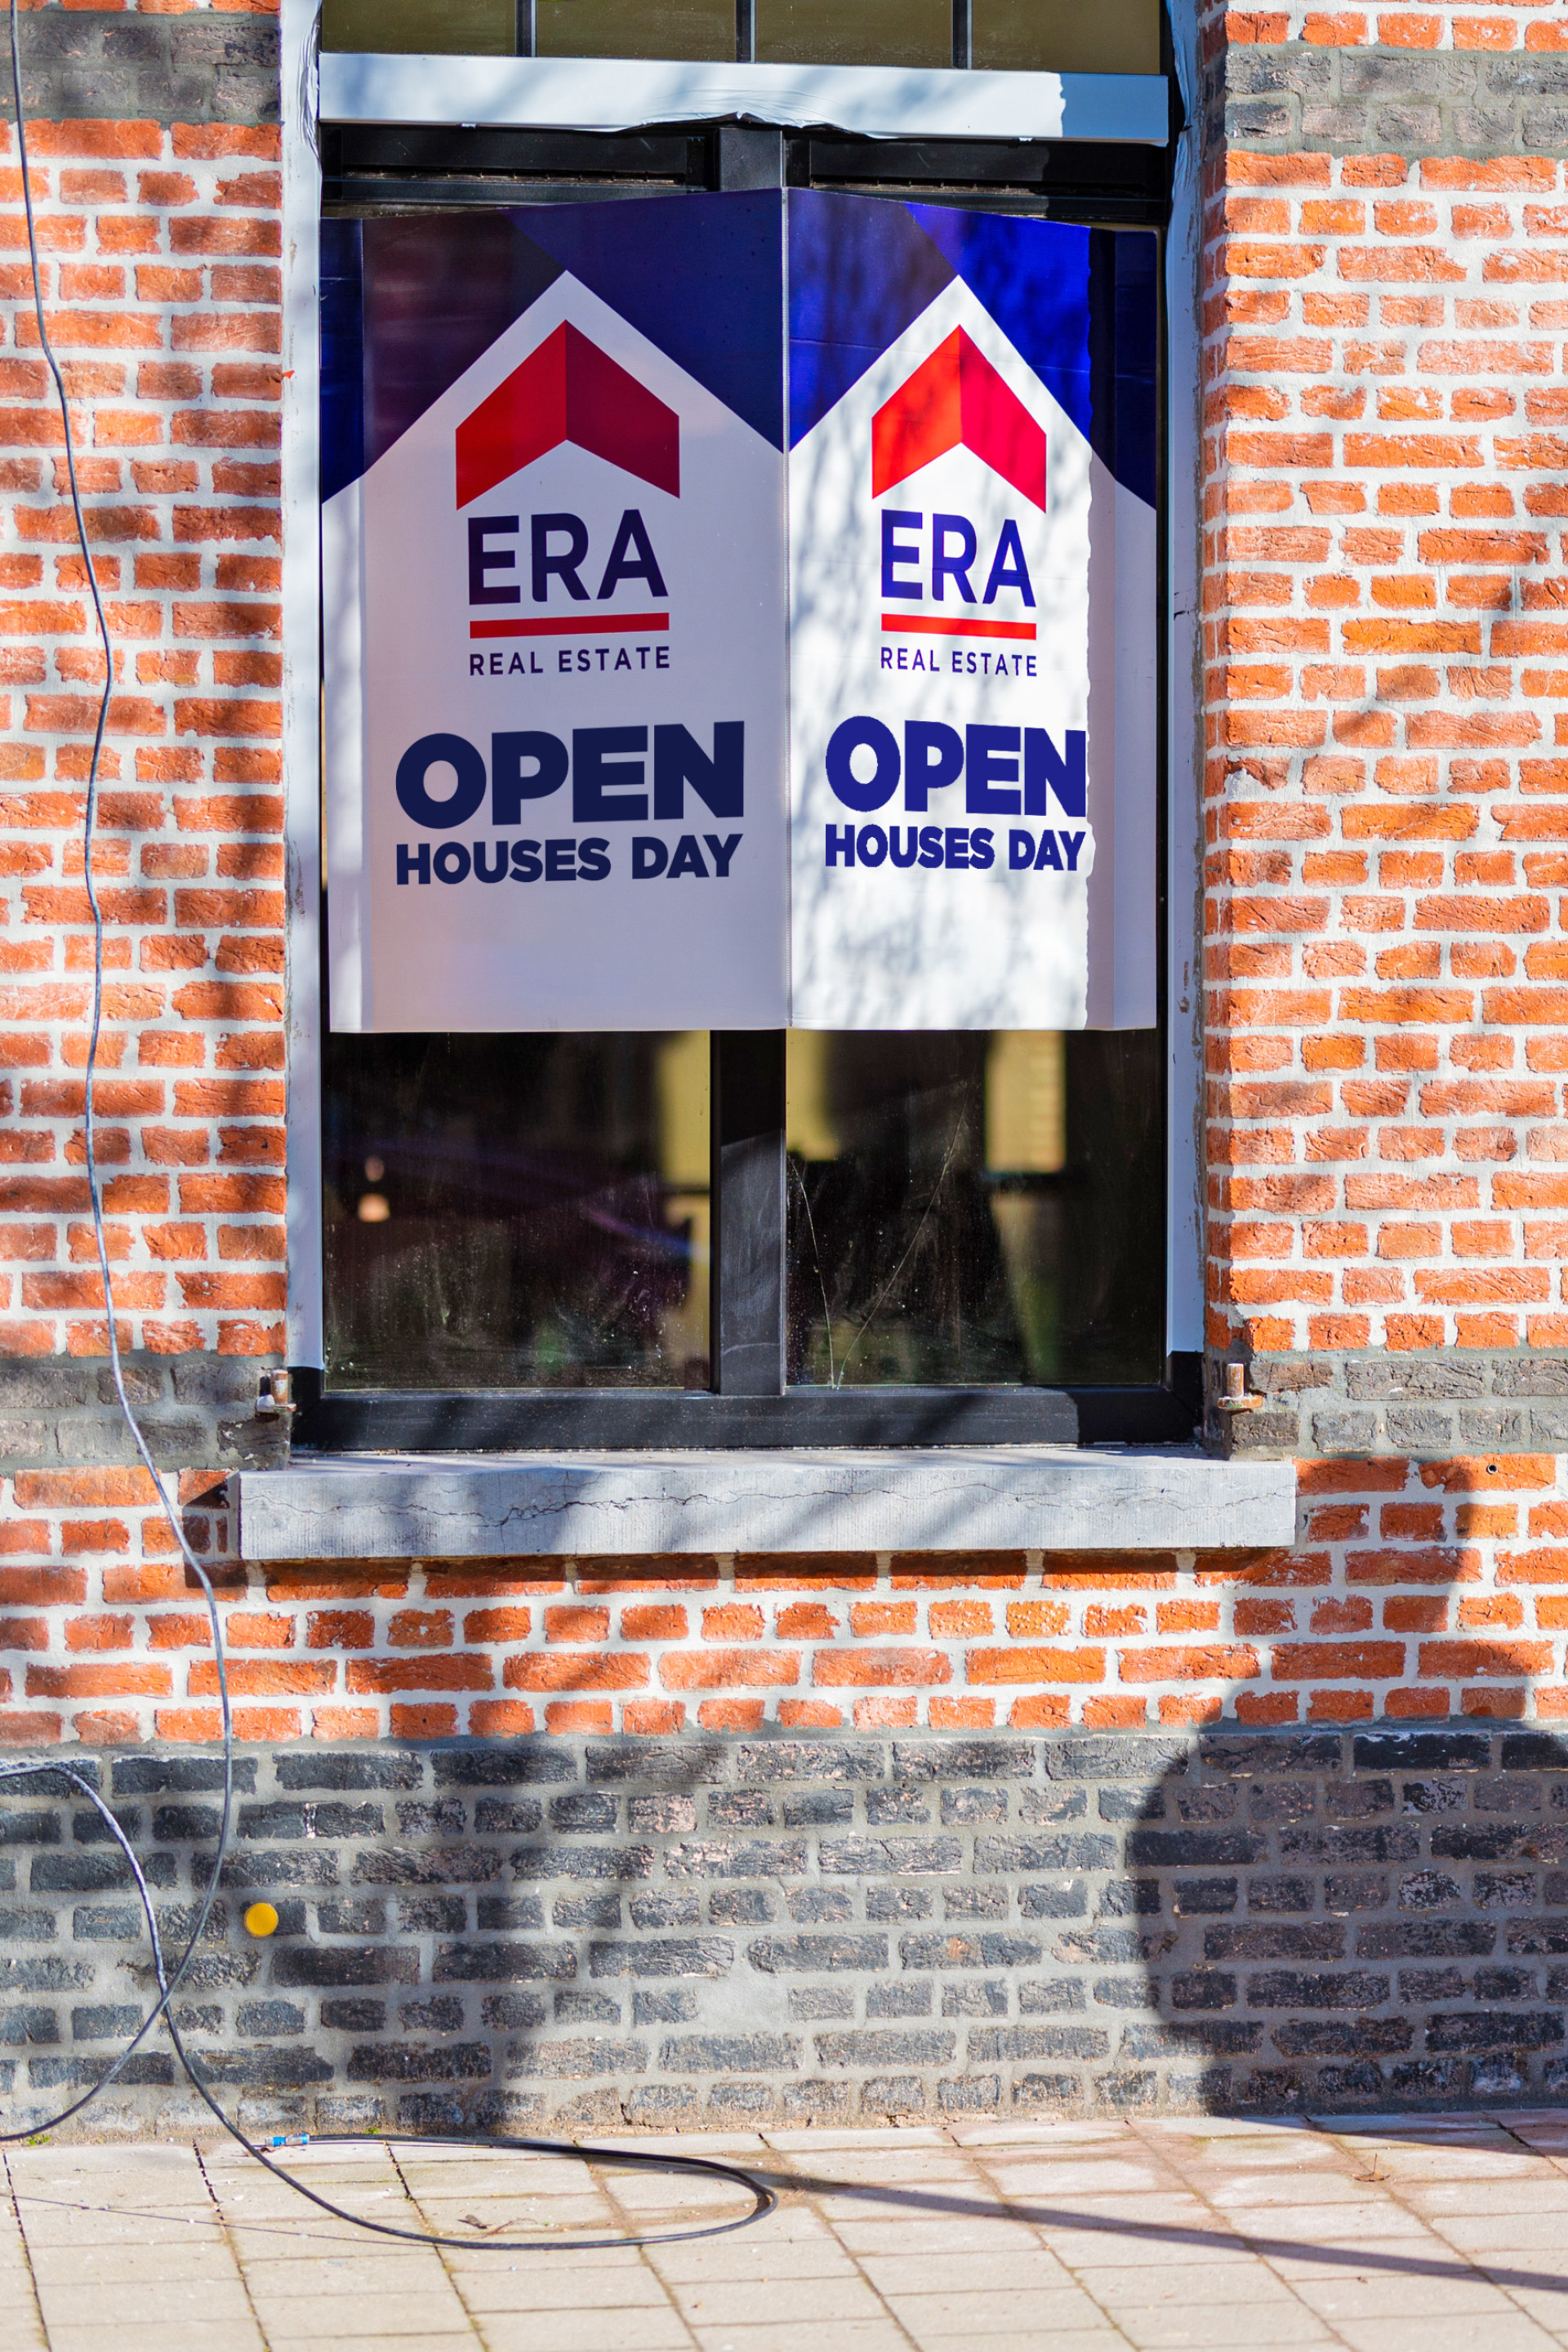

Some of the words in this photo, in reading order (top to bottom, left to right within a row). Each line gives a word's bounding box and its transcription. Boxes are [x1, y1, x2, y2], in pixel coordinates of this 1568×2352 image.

[468, 509, 668, 606] ERA
[881, 509, 1036, 608] ERA
[470, 652, 543, 676] REAL
[559, 646, 670, 673] ESTATE
[880, 647, 940, 672] REAL
[952, 651, 1037, 677] ESTATE
[396, 721, 745, 829] OPEN
[826, 716, 1085, 817] OPEN
[397, 838, 612, 885] HOUSES
[632, 834, 743, 880] DAY
[826, 824, 996, 870] HOUSES
[1009, 830, 1085, 871] DAY
